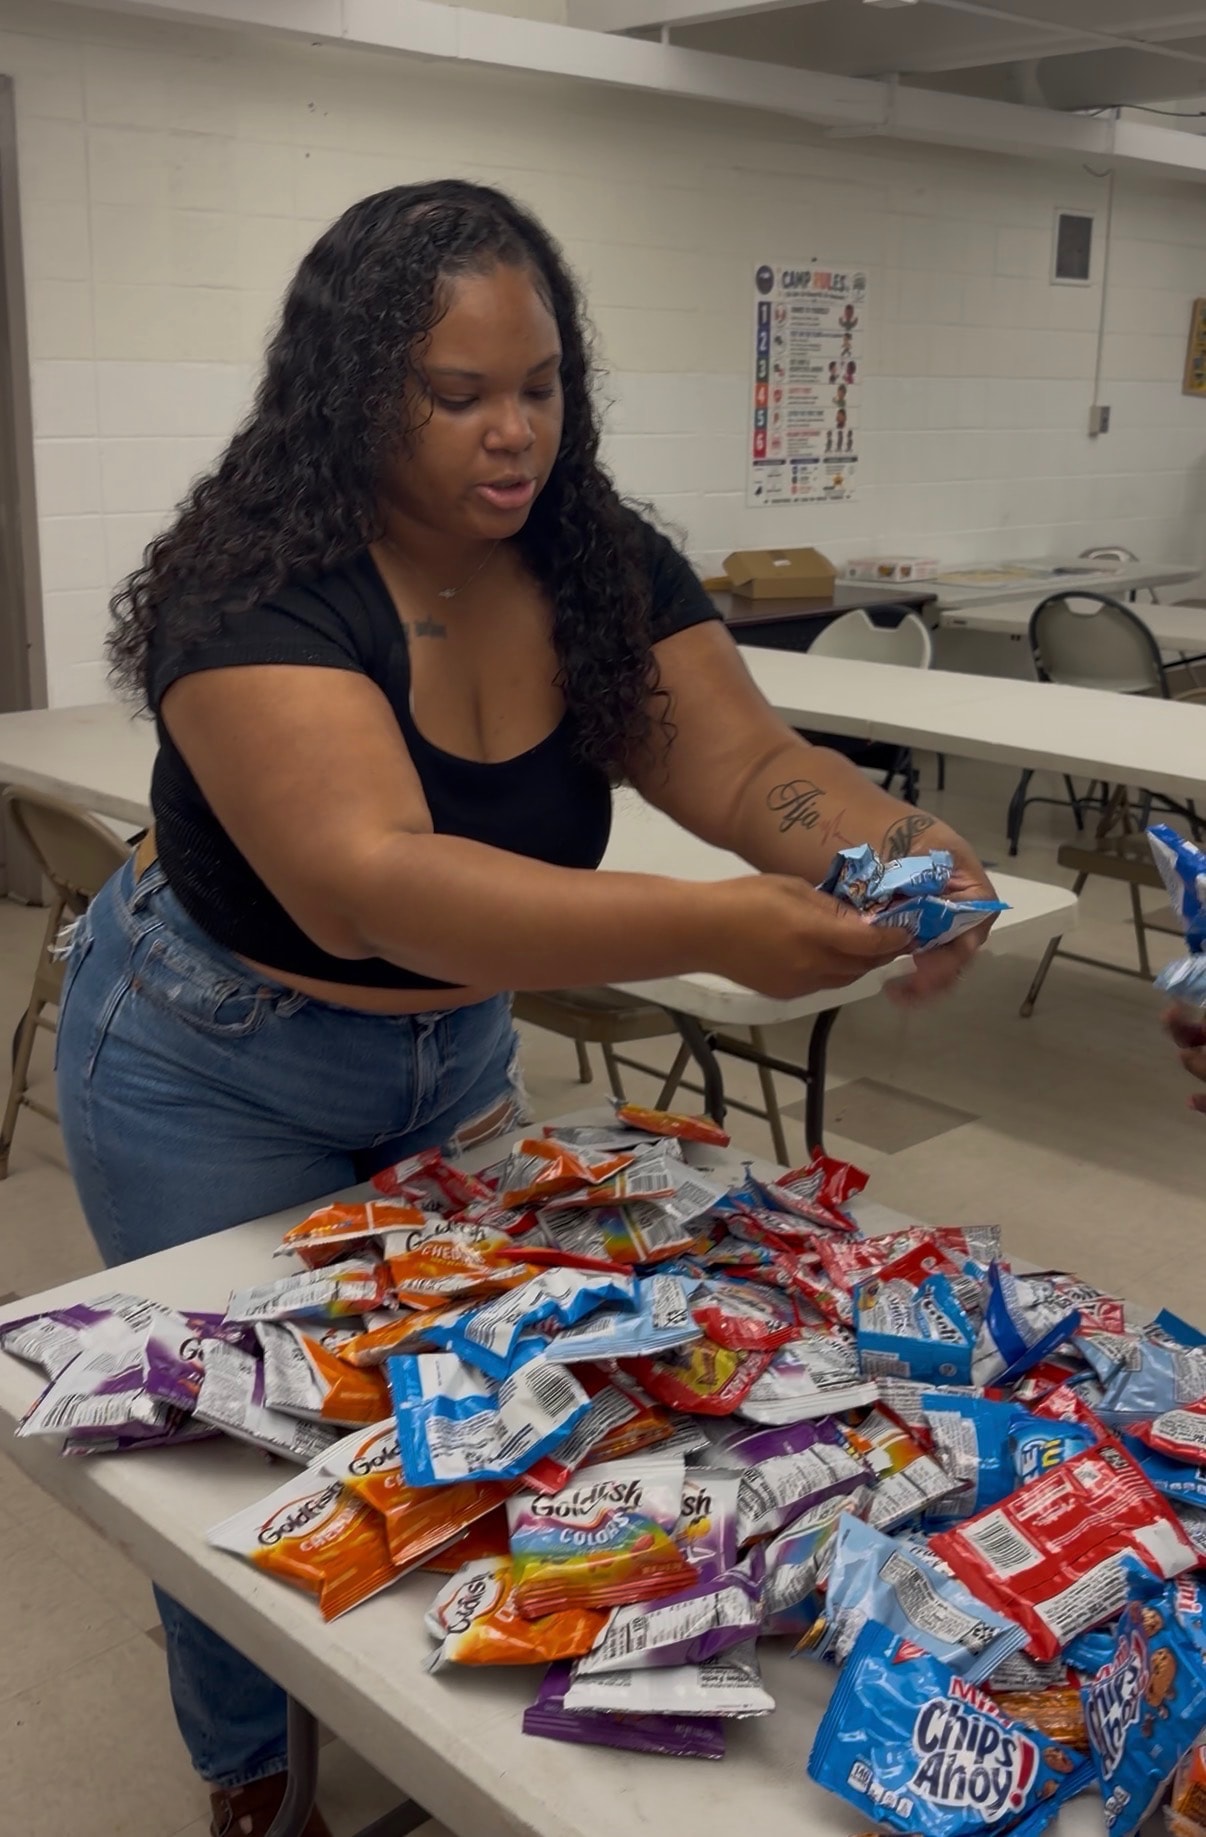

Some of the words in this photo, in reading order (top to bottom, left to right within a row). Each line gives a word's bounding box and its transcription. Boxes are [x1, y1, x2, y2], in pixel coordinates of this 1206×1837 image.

[762, 304, 769, 324] 1
[760, 332, 768, 351] 2
[759, 360, 767, 378] 3
[757, 410, 765, 426] 5
[756, 433, 764, 451] 6
[915, 1699, 1018, 1769] Chips
[911, 1733, 1037, 1818] Ahoy!
